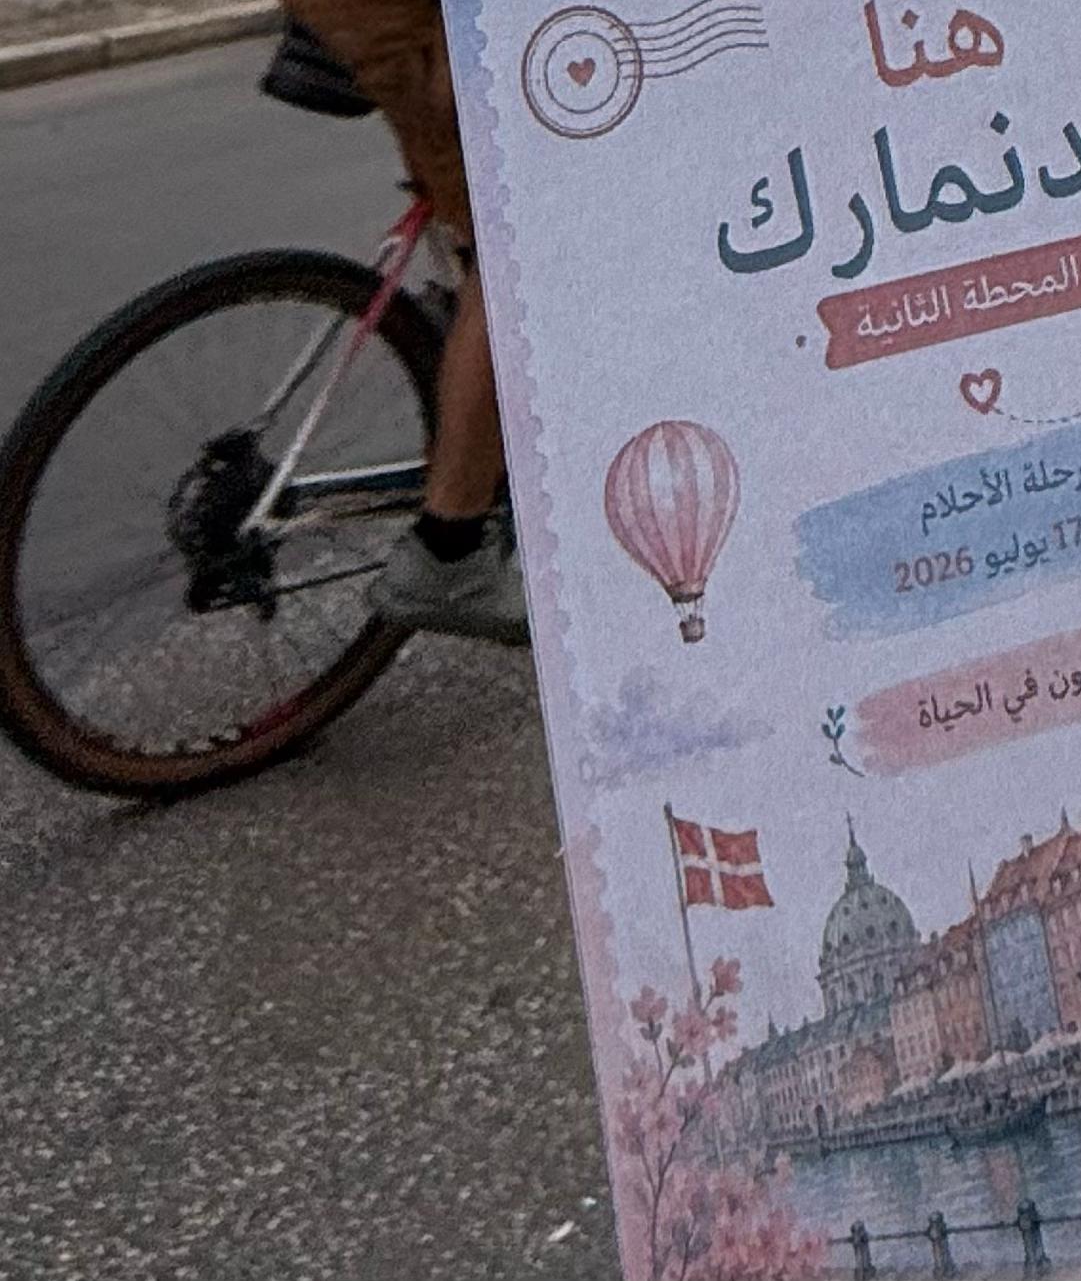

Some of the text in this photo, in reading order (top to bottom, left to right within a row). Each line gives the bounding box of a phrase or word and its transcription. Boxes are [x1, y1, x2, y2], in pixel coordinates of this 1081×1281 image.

[856, 254, 1081, 345] المحطة الثانية
[919, 466, 1014, 536] الأحلام
[893, 545, 975, 593] 2026
[984, 531, 1050, 579] يوليو
[917, 680, 994, 732] الحياة
[1002, 668, 1040, 723] في
